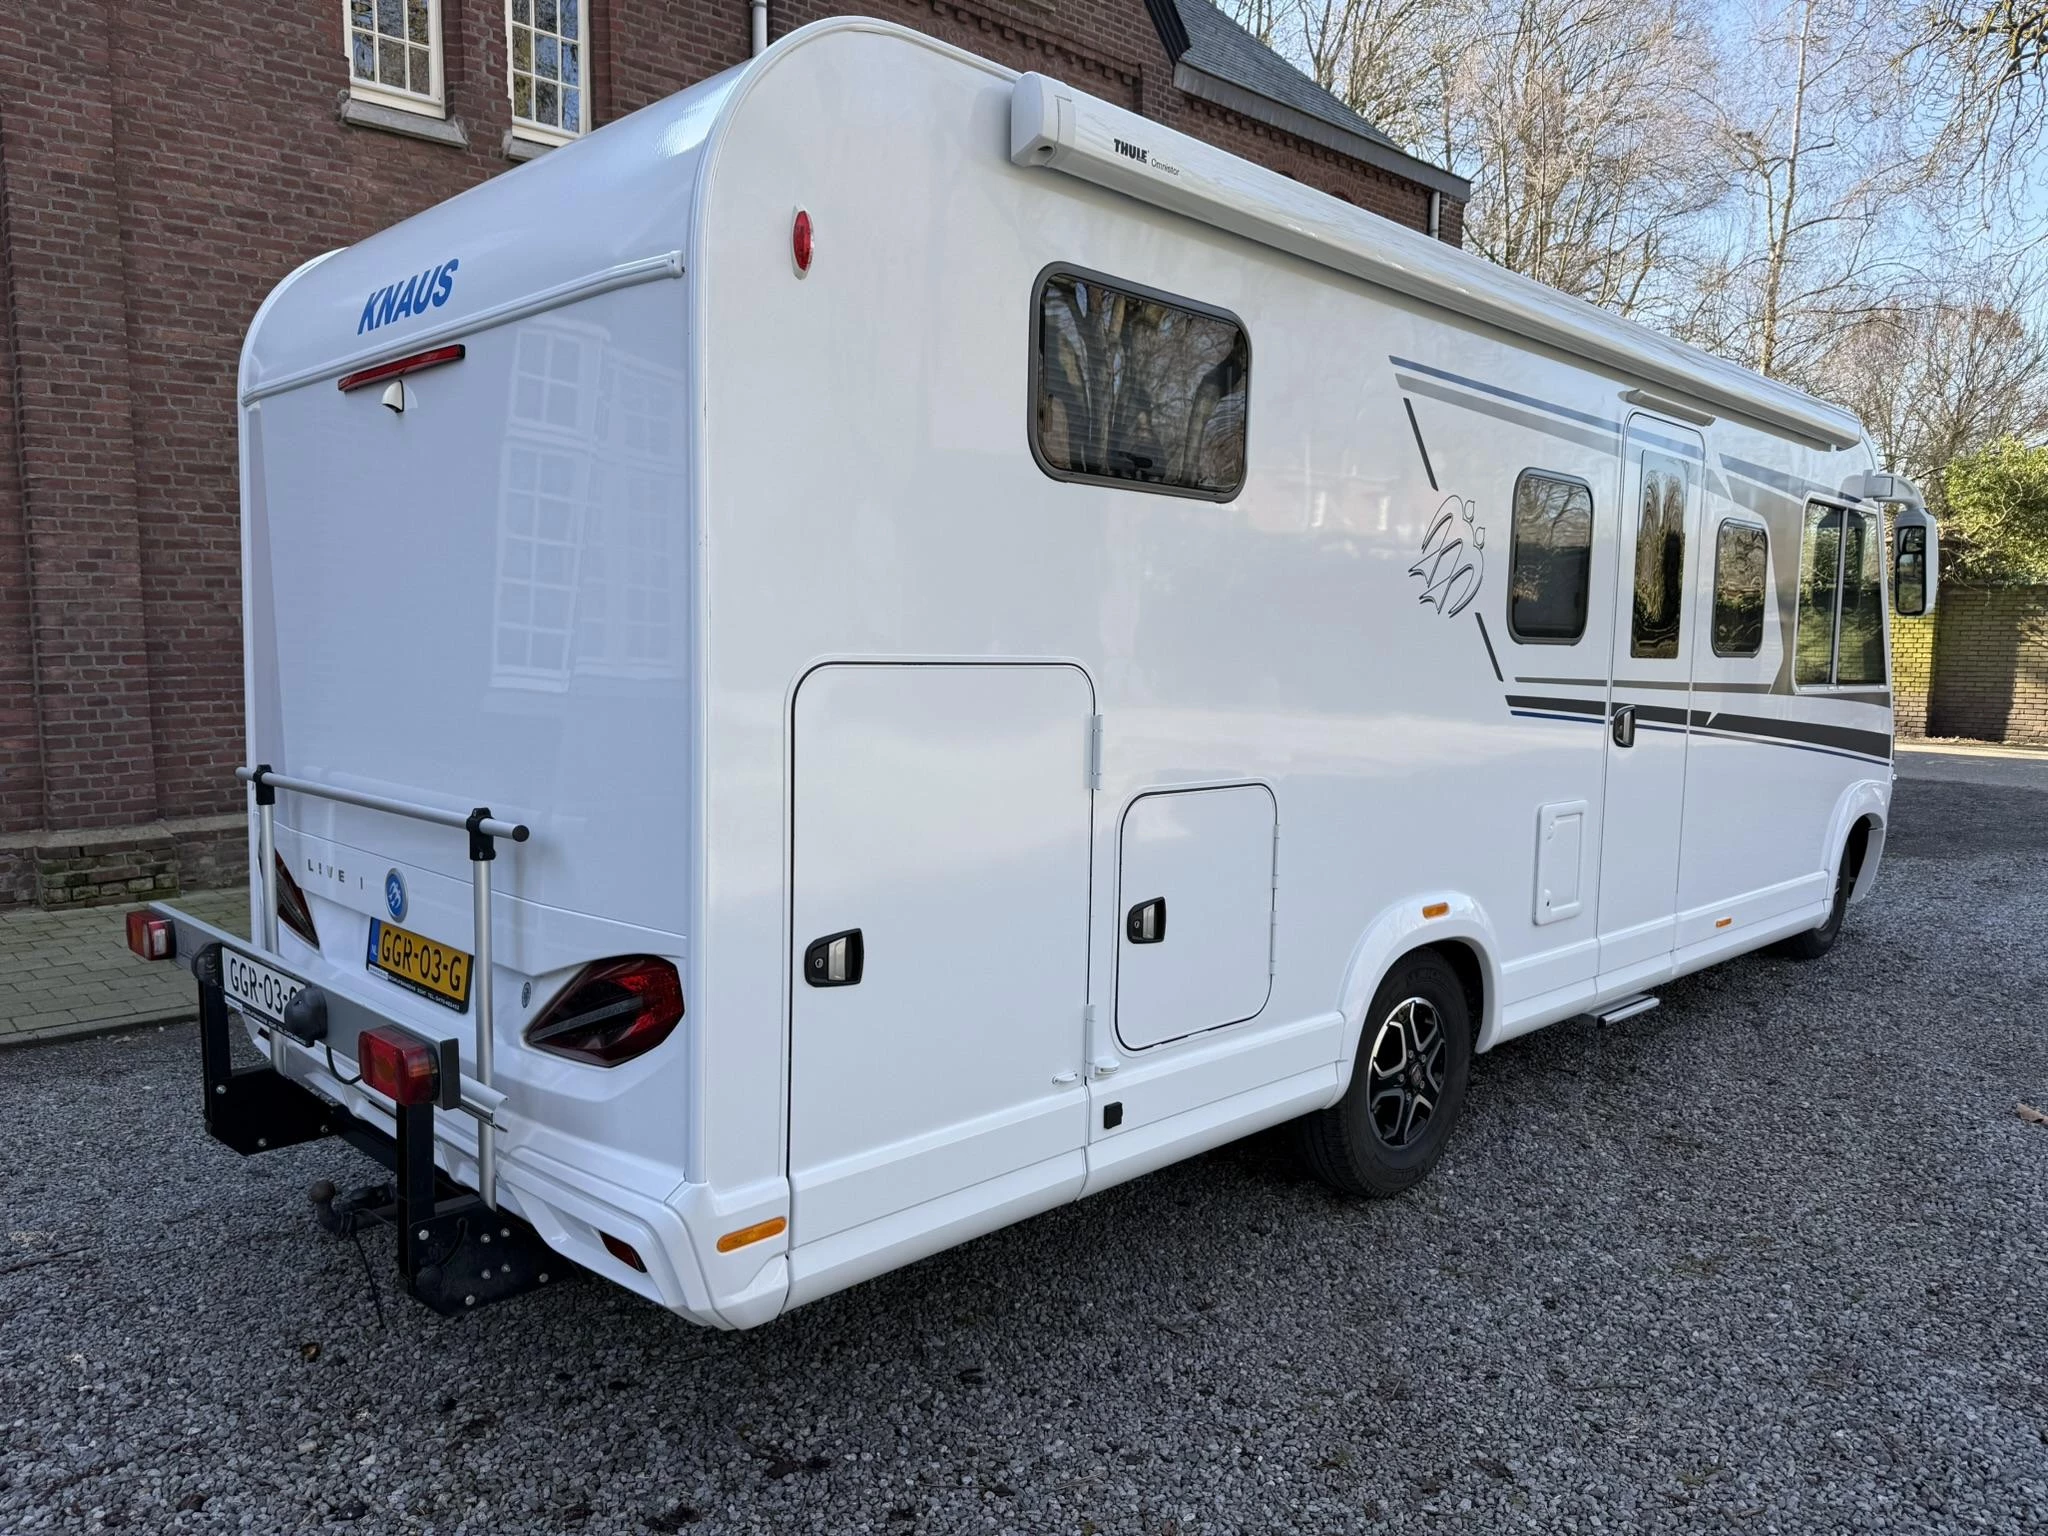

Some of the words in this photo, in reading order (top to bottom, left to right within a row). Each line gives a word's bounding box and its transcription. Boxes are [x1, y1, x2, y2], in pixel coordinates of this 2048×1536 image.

[1114, 138, 1148, 164] THULE
[1151, 158, 1180, 176] Omnistor
[357, 258, 459, 336] KNAUS
[307, 859, 345, 883] LIVE
[382, 929, 462, 992] GGR-03-G
